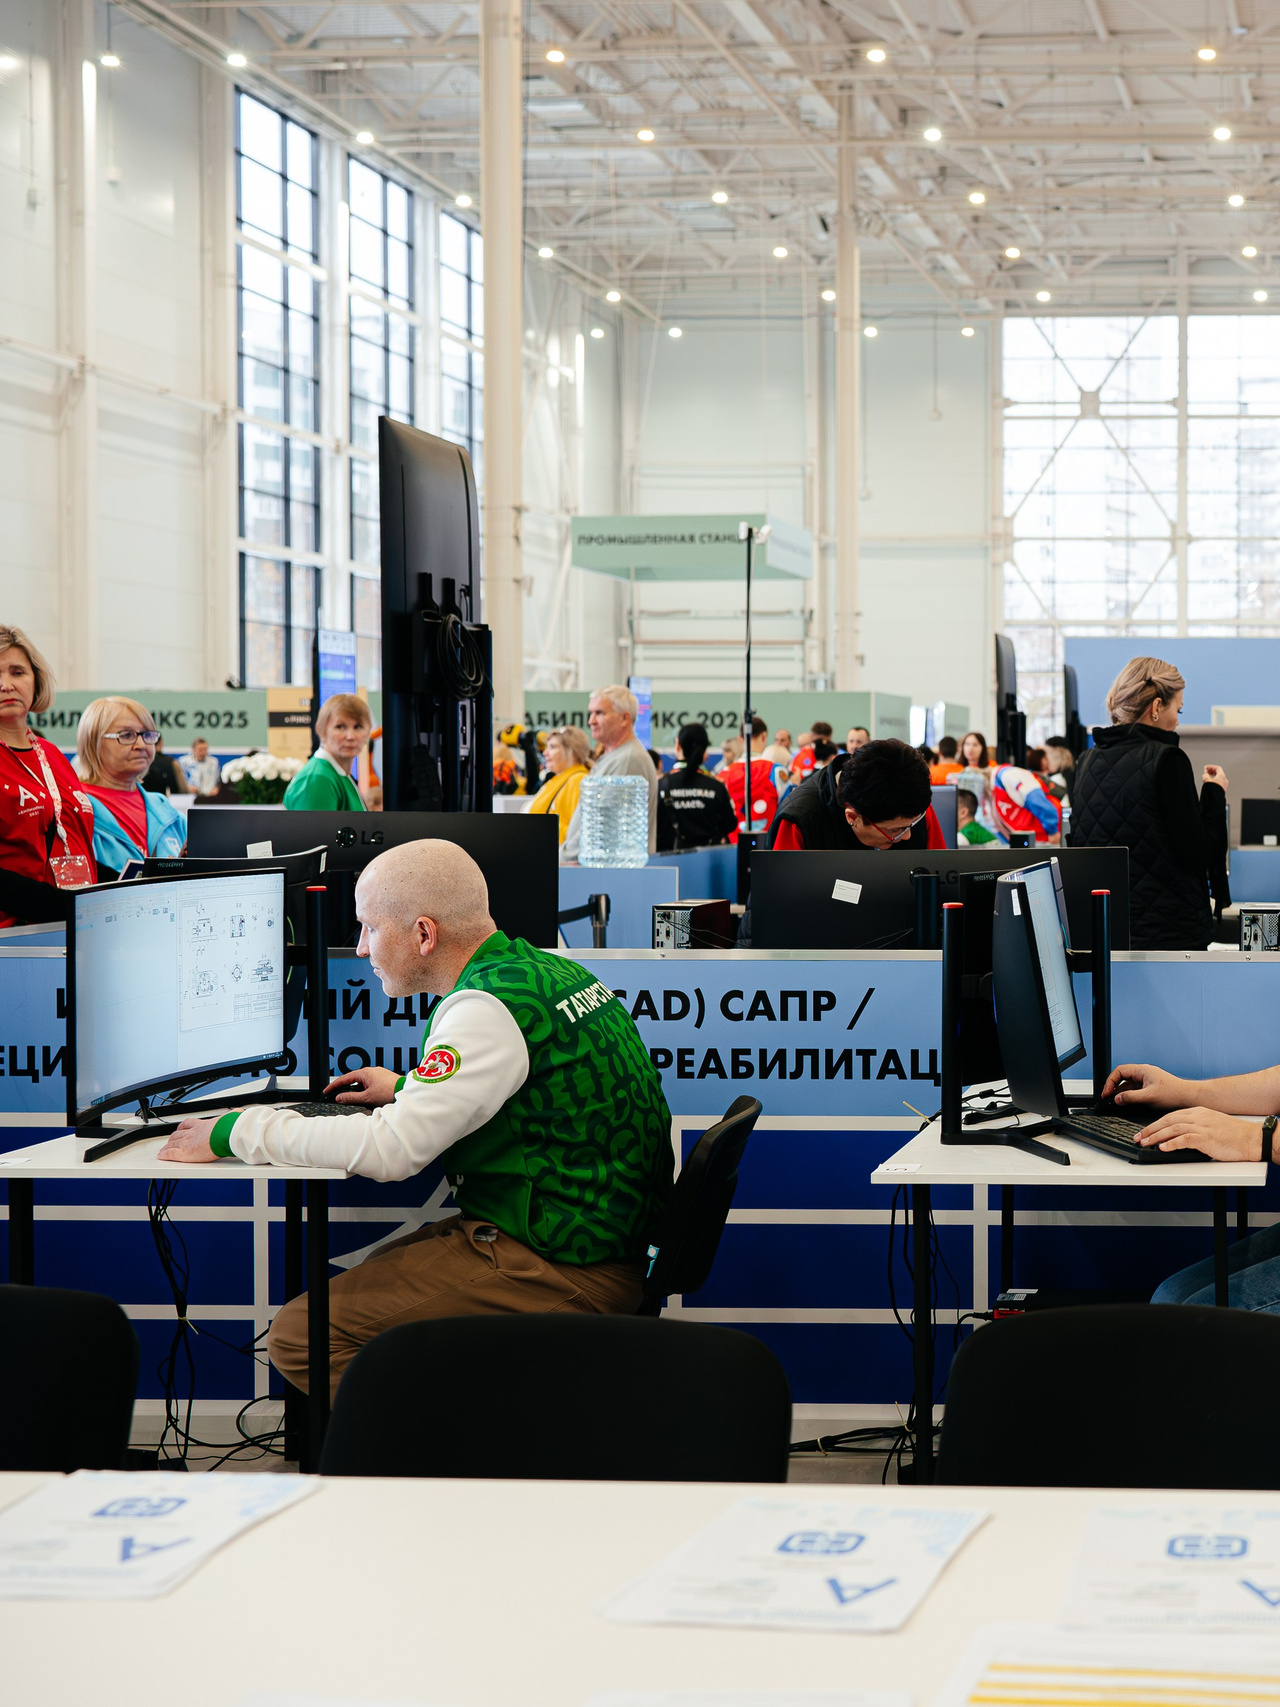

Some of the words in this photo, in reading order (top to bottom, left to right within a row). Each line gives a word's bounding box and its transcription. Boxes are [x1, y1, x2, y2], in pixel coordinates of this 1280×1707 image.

[577, 533, 696, 546] ПРОМЫШЛЕННАЯ
[698, 532, 746, 545] СТАНЦ
[194, 710, 249, 729] 2025
[697, 711, 739, 729] 202
[361, 830, 385, 845] LG
[555, 980, 615, 1024] ТАТАРСТА
[719, 989, 837, 1022] САПР
[656, 1047, 942, 1087] РЕАБИЛИТАЦ
